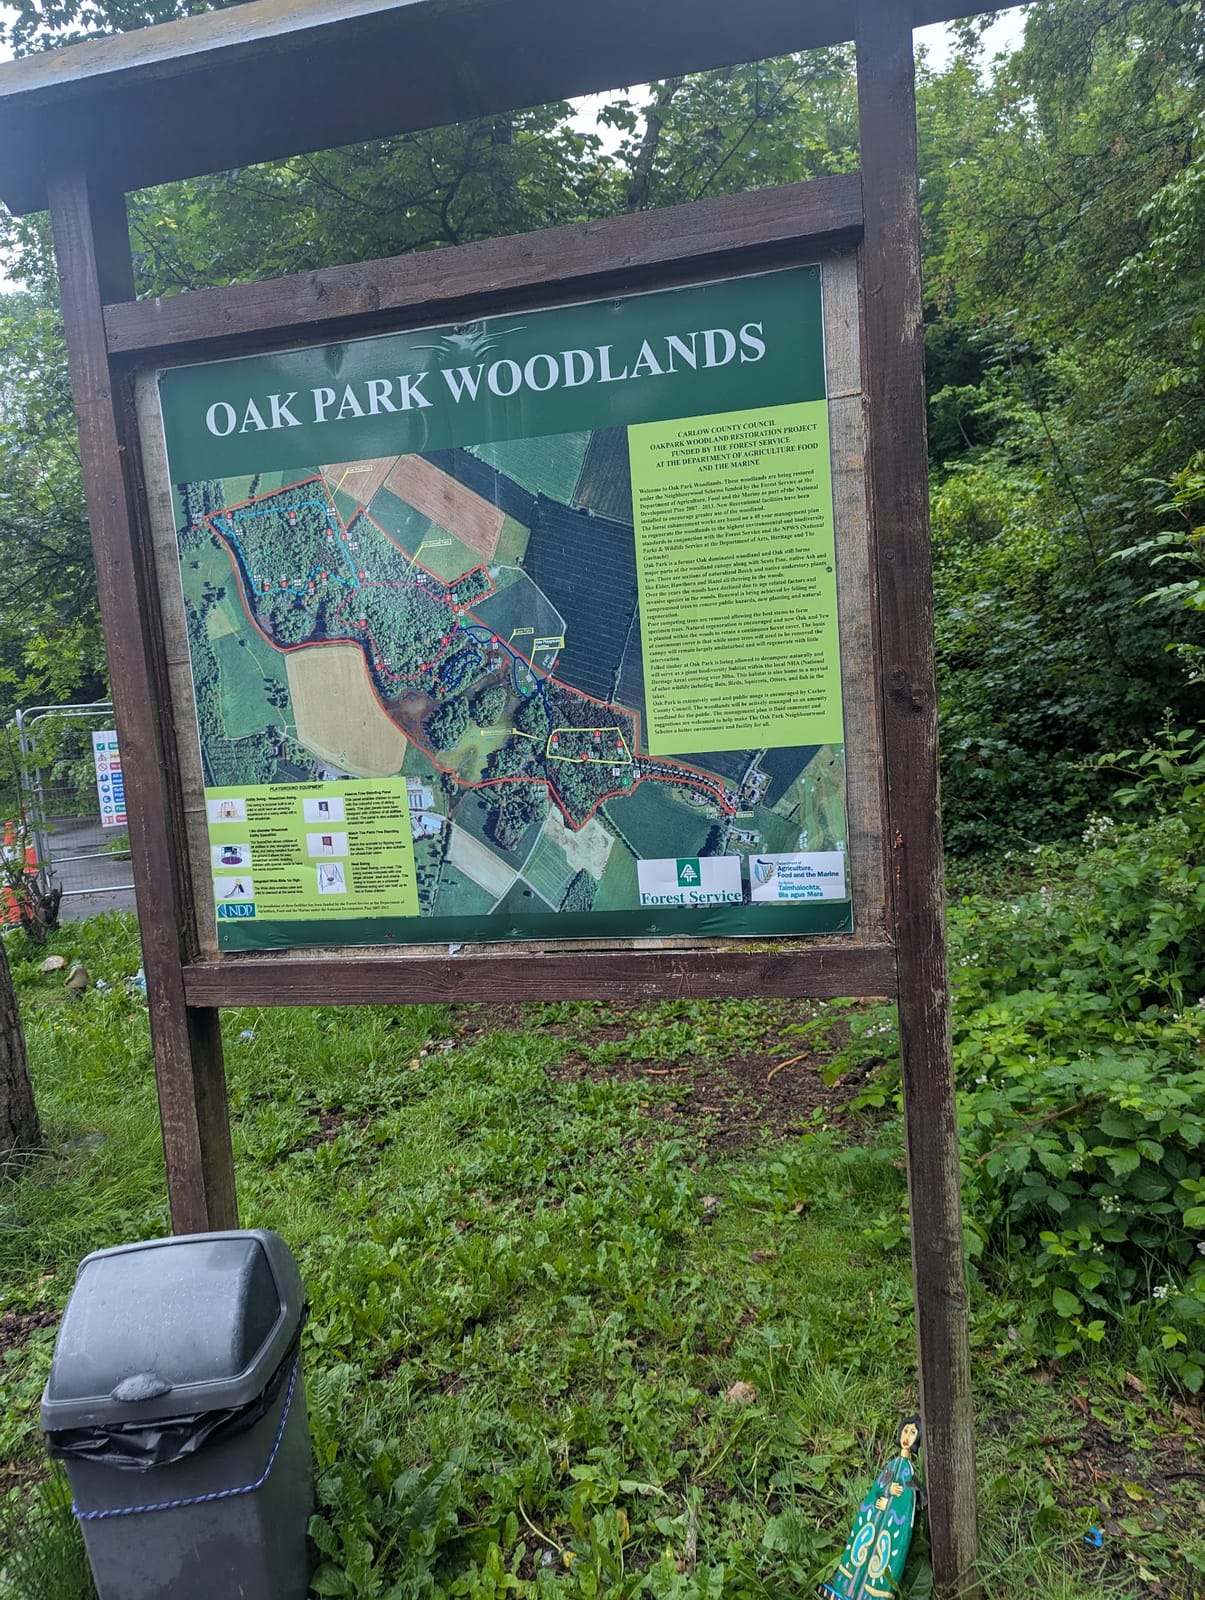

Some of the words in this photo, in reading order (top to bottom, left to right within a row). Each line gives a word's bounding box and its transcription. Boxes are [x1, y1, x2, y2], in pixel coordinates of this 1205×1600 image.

[205, 391, 304, 438] OAK
[311, 371, 433, 423] PARK
[440, 321, 767, 404] WOODLANDS
[649, 440, 685, 450] OAKPARK
[685, 435, 728, 445] WOODLAND
[730, 428, 782, 440] RESTORATION
[783, 424, 815, 433] PROJECT
[677, 428, 710, 437] CARLOW
[710, 424, 742, 433] COUNTY
[742, 420, 776, 429] COUNCIL
[671, 448, 700, 456] FUNDED
[729, 441, 756, 449] FOREST
[756, 437, 790, 446] SERVICE
[682, 453, 731, 464] DEPARTMENT
[743, 445, 796, 457] AGRICULTURE
[730, 459, 760, 467] MARINE
[777, 864, 813, 872] Agriculture,
[641, 892, 685, 905] Forest
[689, 889, 742, 903] Service
[228, 905, 253, 916] NDP
